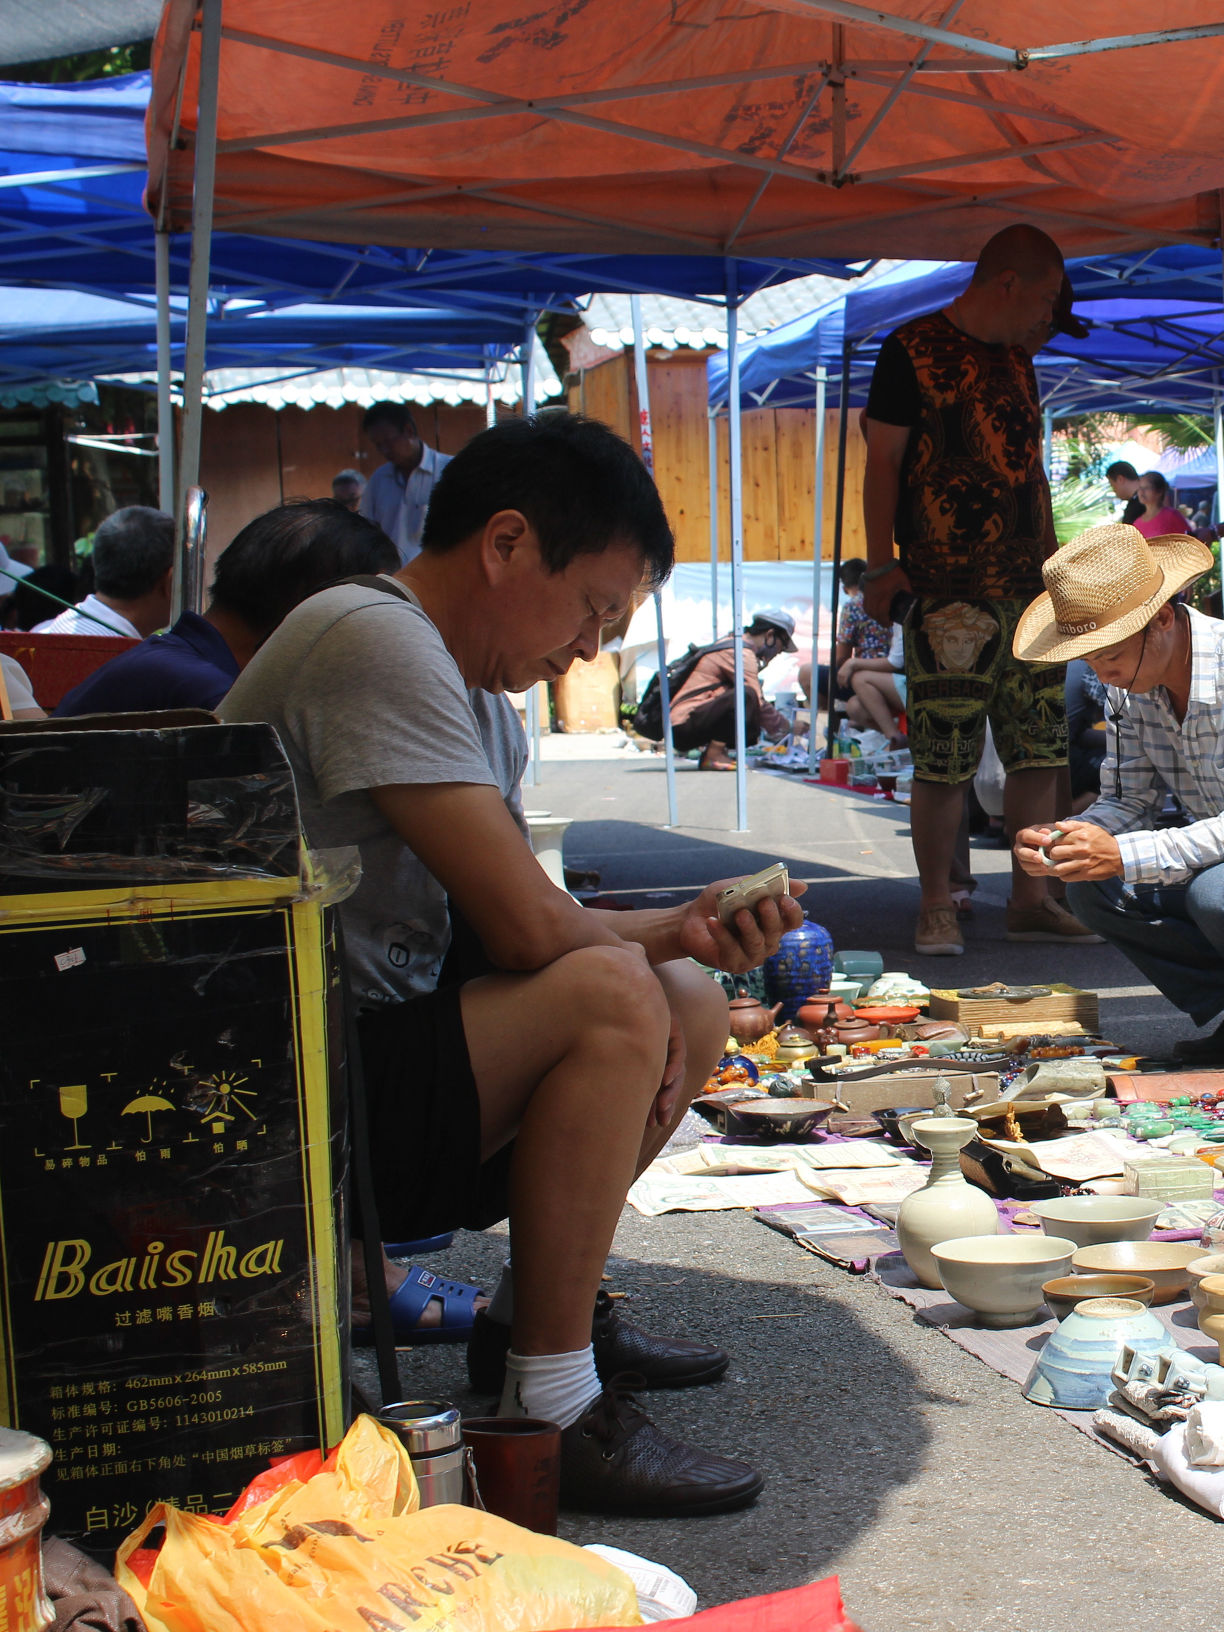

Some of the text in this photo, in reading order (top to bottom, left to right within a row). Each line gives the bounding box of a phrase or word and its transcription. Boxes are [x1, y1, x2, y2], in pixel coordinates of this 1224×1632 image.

[135, 1148, 171, 1163] 怕雨
[212, 1140, 248, 1154] 怕晒
[44, 1154, 108, 1171] 易碎物品
[34, 1229, 286, 1301] Baisha
[114, 1301, 216, 1328] 过滤嘴香烟
[175, 1405, 255, 1427] 1143010214
